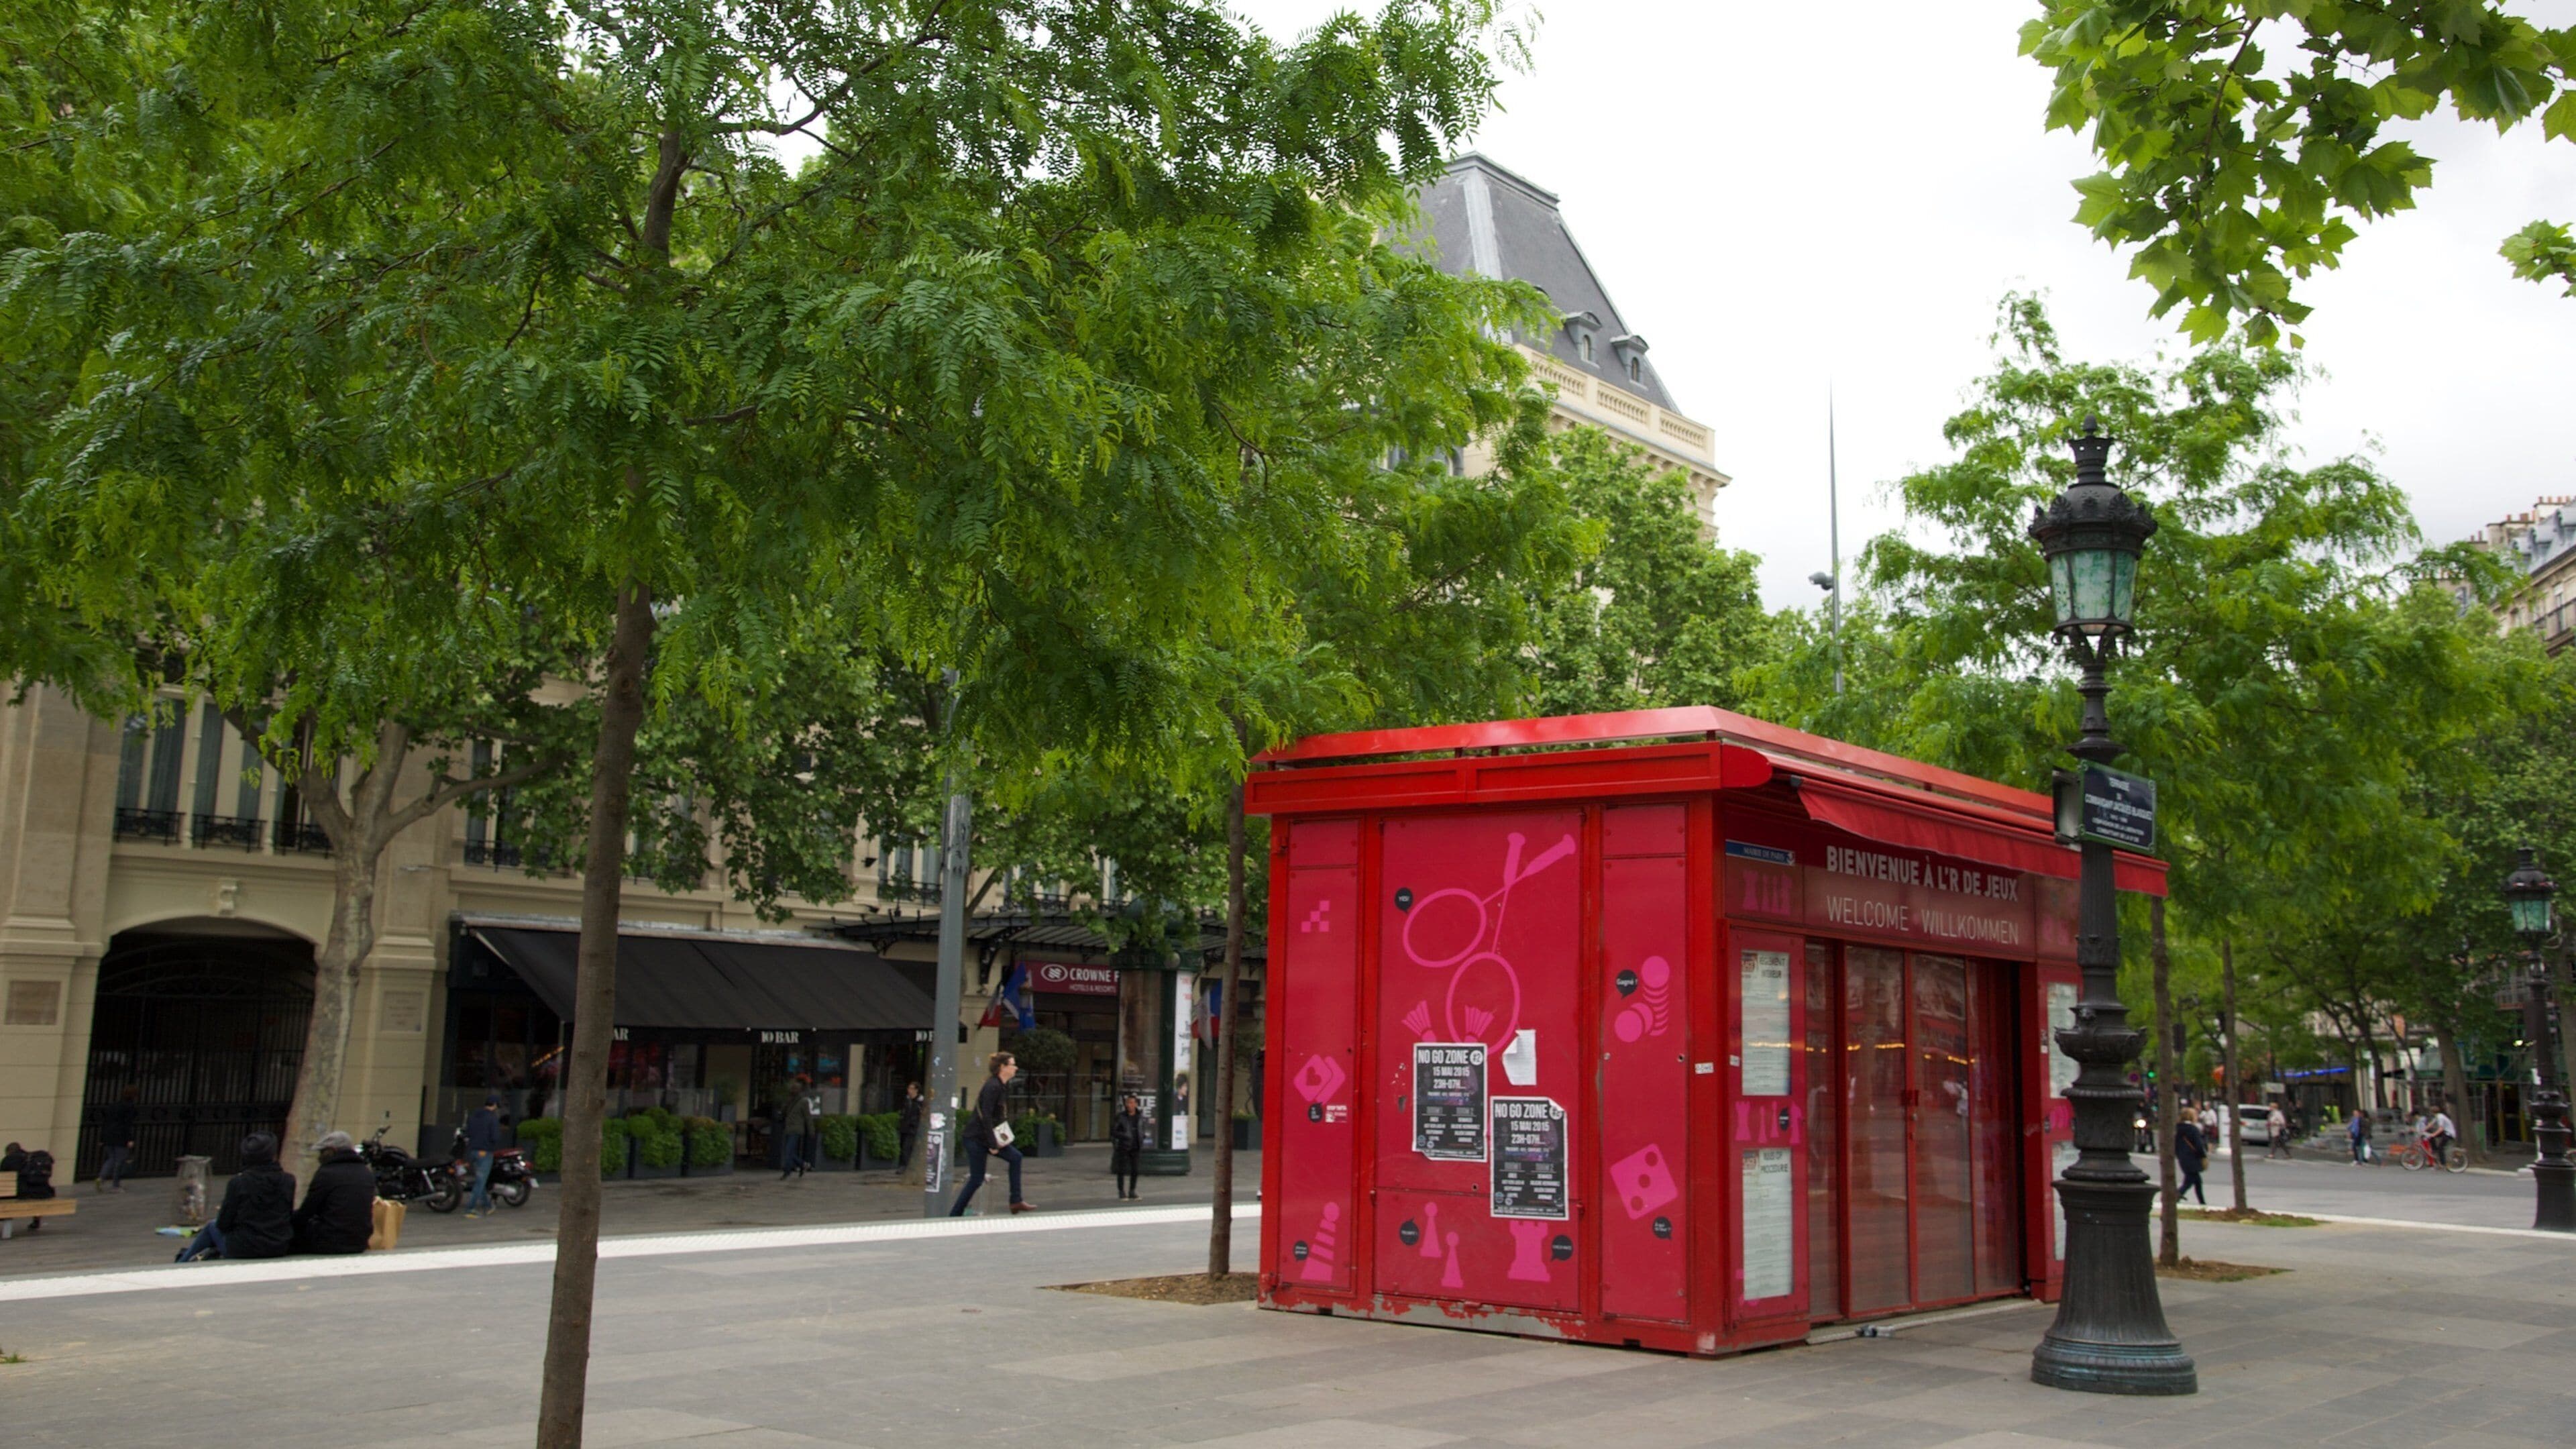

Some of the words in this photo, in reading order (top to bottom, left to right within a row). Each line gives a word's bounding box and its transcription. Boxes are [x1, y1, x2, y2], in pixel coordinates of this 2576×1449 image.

[1826, 845, 1919, 886] BIENVENUE
[1923, 855, 1933, 887] À
[1963, 871, 1980, 896] DE
[1984, 875, 2018, 902] JEUX
[1827, 896, 1909, 932] WELCOME
[1921, 909, 2019, 945] WILLKOMMEN
[1069, 968, 1112, 982] CROWNE
[612, 1028, 629, 1040] AR
[775, 1031, 799, 1044] BAR
[1417, 1049, 1430, 1064] NO
[1432, 1049, 1444, 1064] GO
[1445, 1049, 1469, 1064] ZONE
[1433, 1066, 1440, 1077] 15
[1441, 1067, 1453, 1077] MAI
[1454, 1067, 1470, 1077] 2015
[1495, 1103, 1508, 1118] NO
[1509, 1103, 1522, 1118] GO
[1523, 1104, 1548, 1119] ZONE
[1511, 1121, 1519, 1131] 15
[1519, 1121, 1532, 1131] MAI
[1532, 1122, 1550, 1132] 2015
